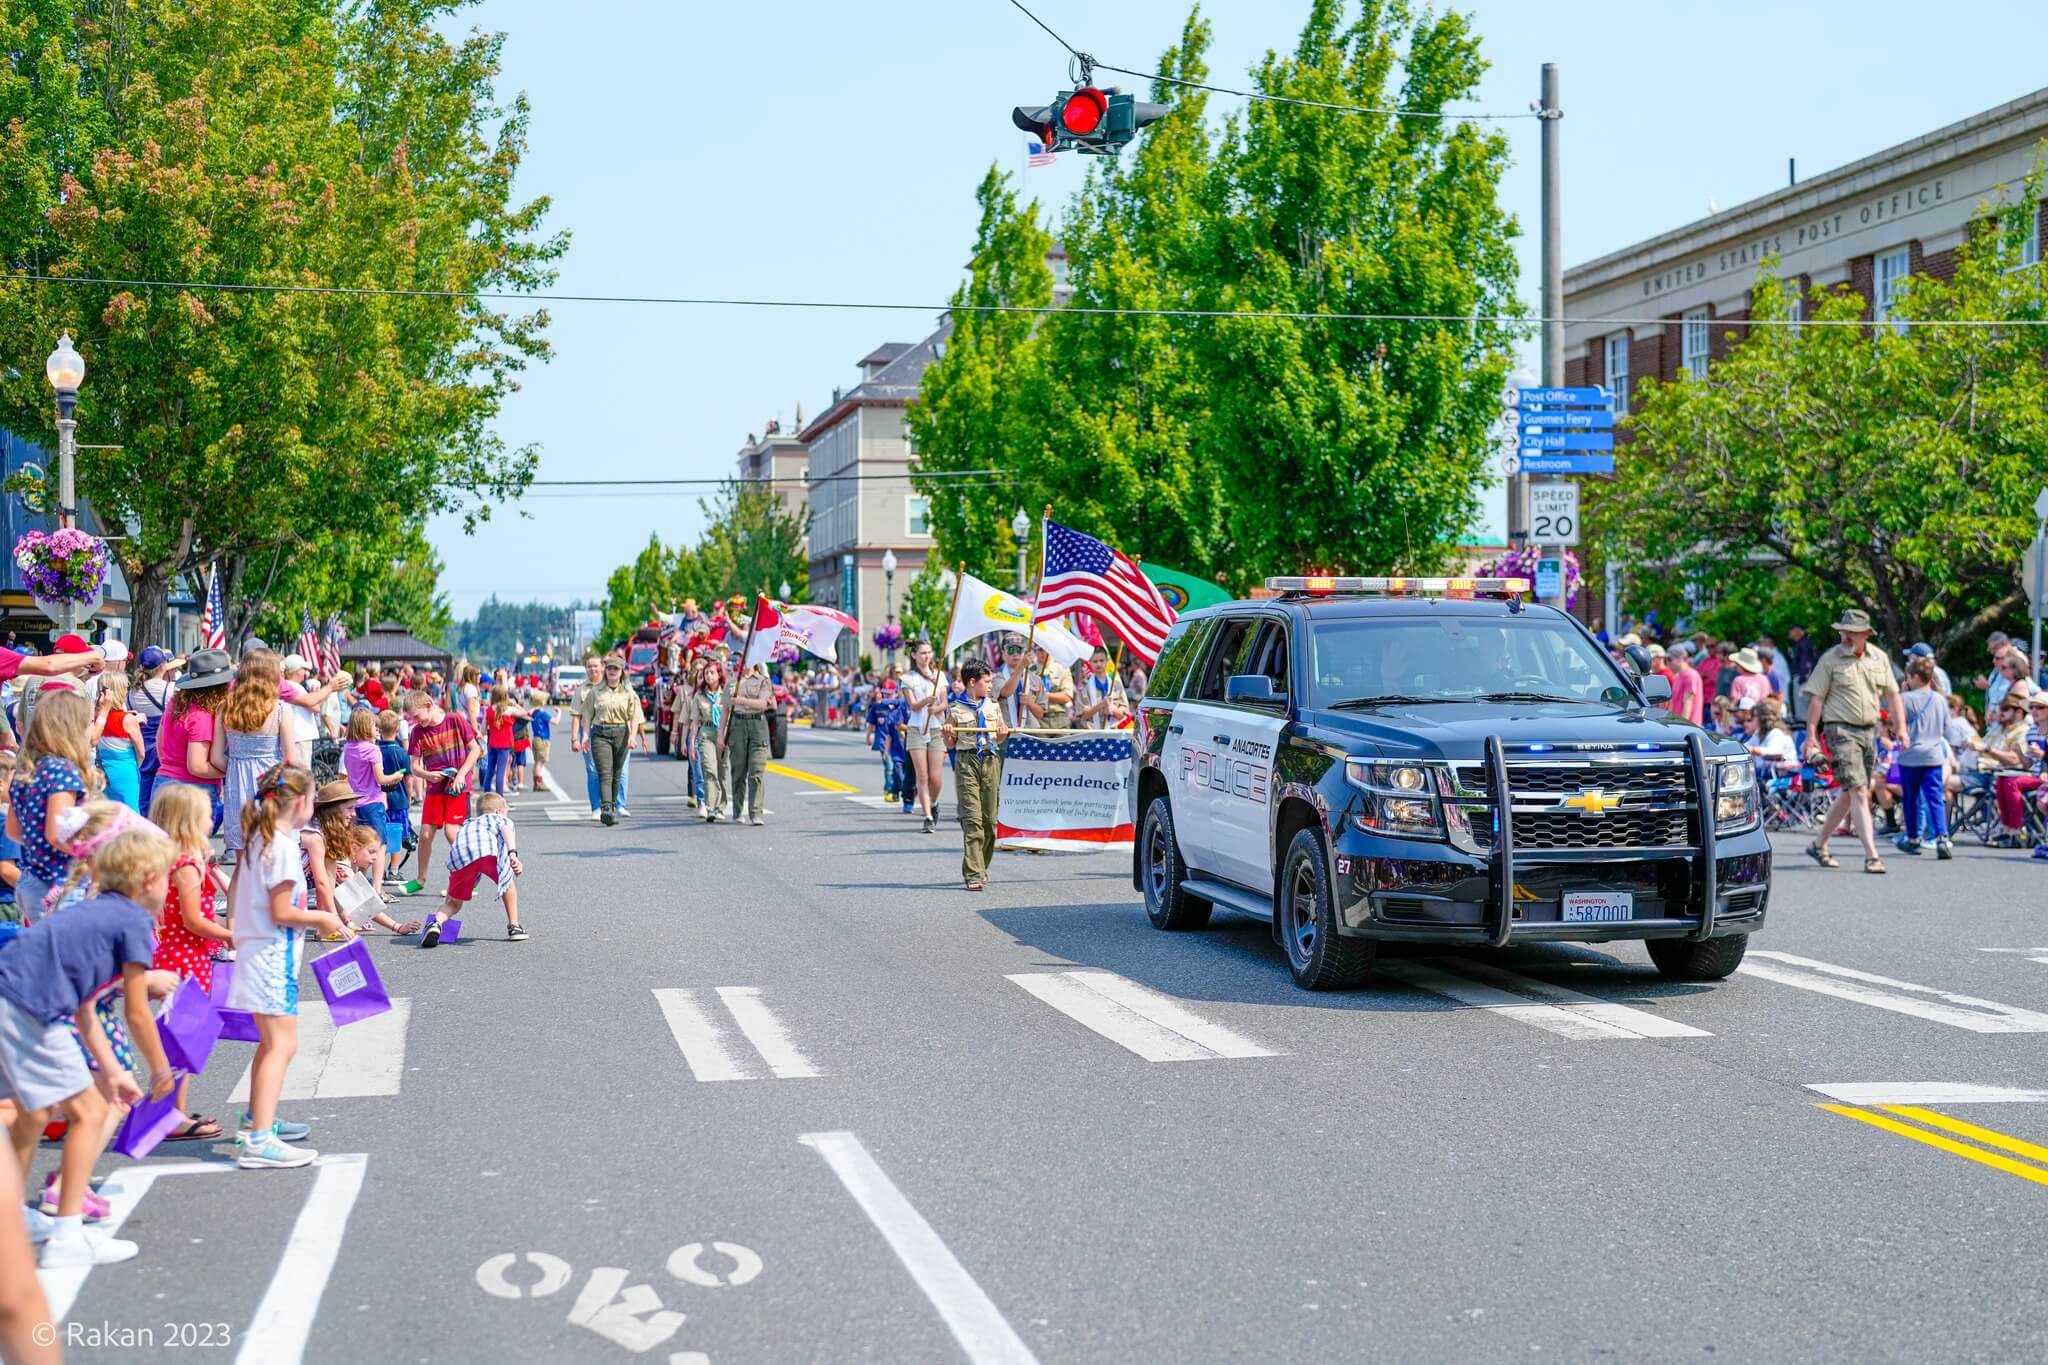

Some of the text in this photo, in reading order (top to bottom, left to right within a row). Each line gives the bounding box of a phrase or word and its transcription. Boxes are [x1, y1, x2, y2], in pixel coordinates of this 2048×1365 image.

[1643, 180, 1945, 296] UNITED STATES POST OFFICE
[1523, 391, 1576, 402] Post Office
[1523, 413, 1592, 426] Guemes Ferry
[1524, 436, 1565, 448] City Hall
[1523, 459, 1572, 469] Restroom
[1533, 490, 1573, 501] SPEED
[1537, 503, 1568, 513] LIMIT
[1535, 516, 1573, 537] 20
[1232, 738, 1271, 759] ANACORTES
[1006, 773, 1120, 791] Independence
[1180, 747, 1268, 805] POLICE
